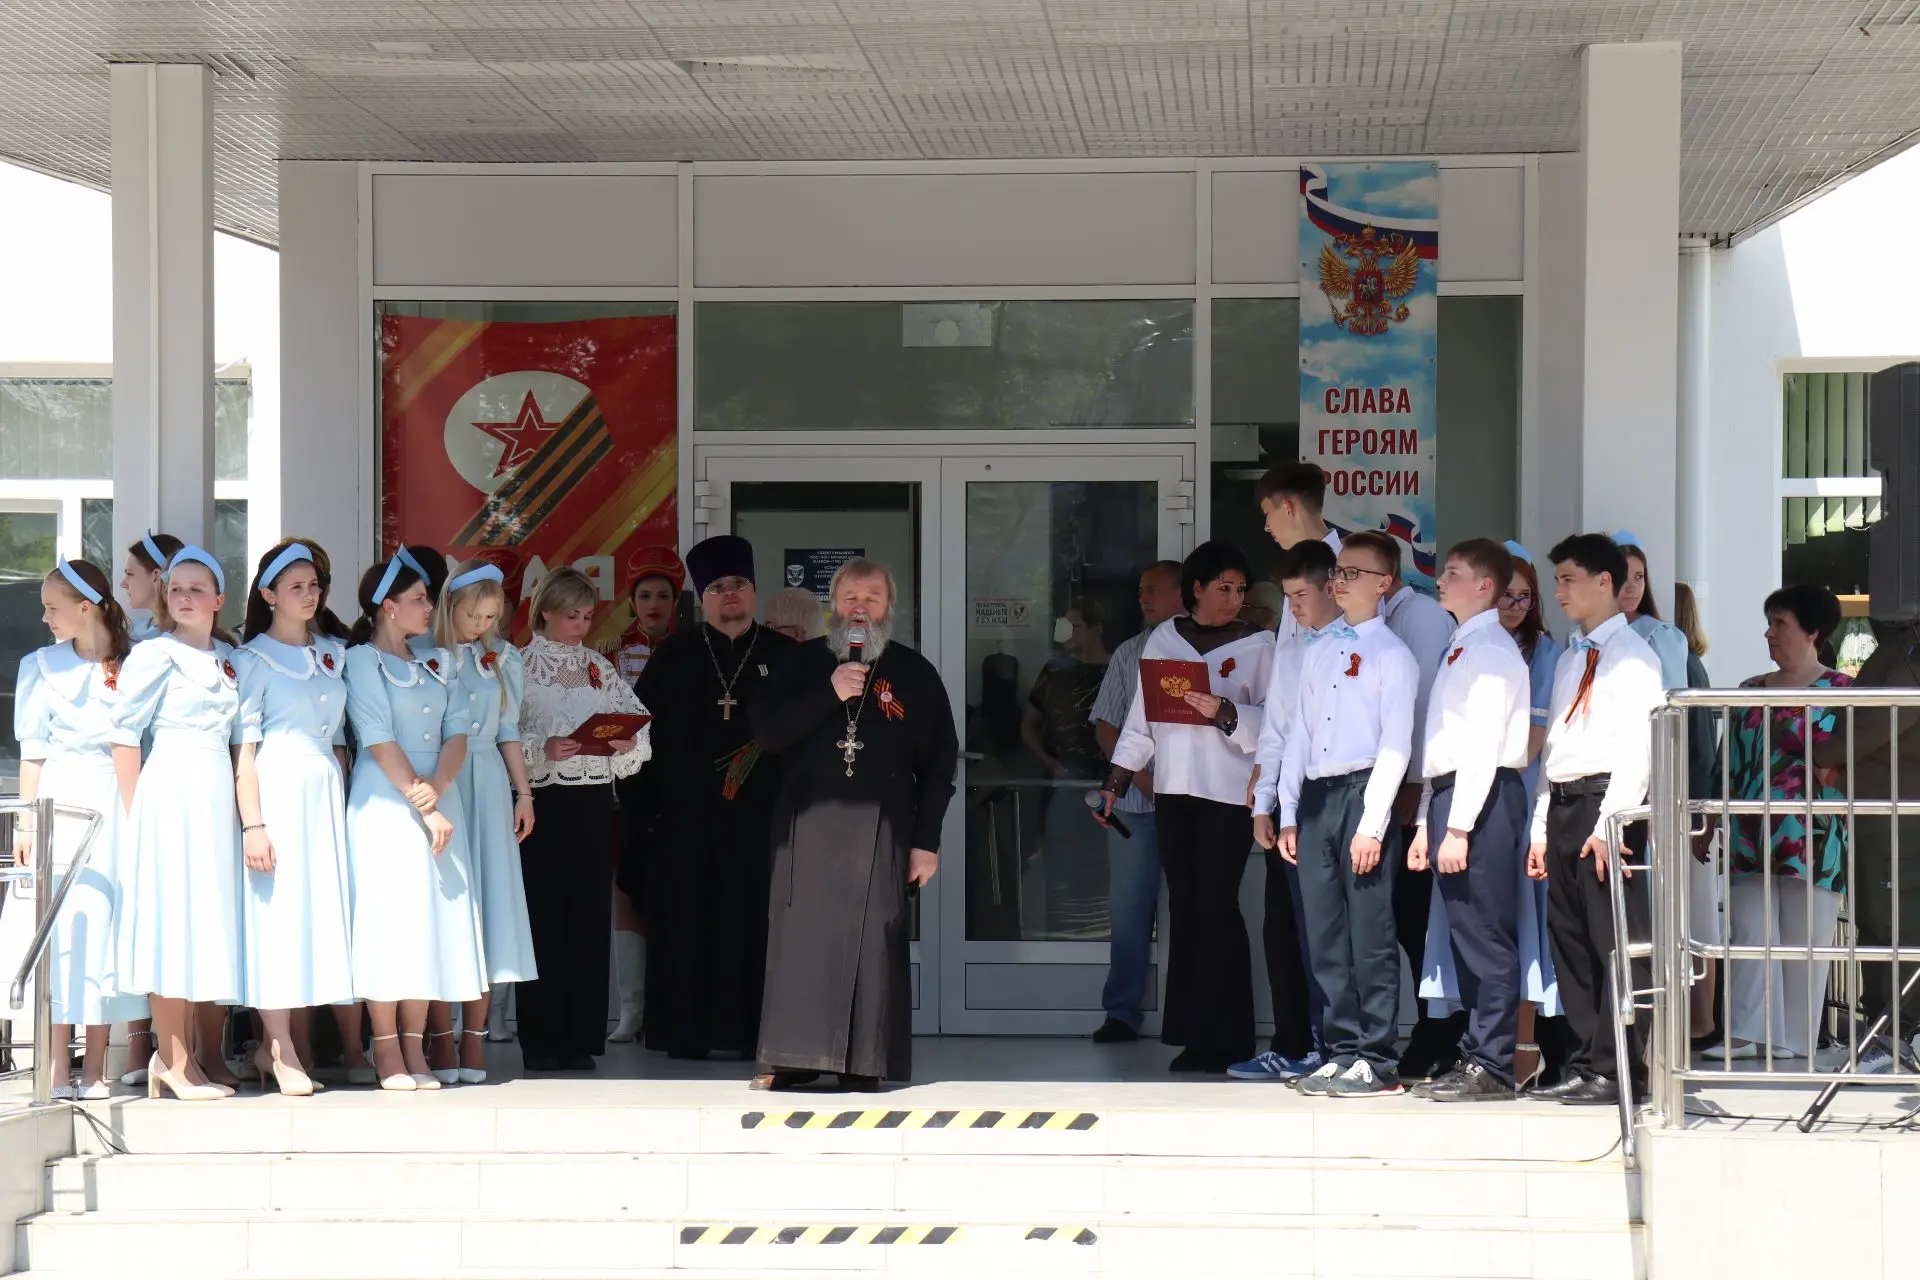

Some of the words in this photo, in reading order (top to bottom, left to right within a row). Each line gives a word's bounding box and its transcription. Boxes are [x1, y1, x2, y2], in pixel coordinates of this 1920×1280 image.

[1325, 387, 1412, 414] СЛАВА
[1318, 428, 1418, 455] ГЕРОЯМ
[446, 554, 615, 601] АЯ
